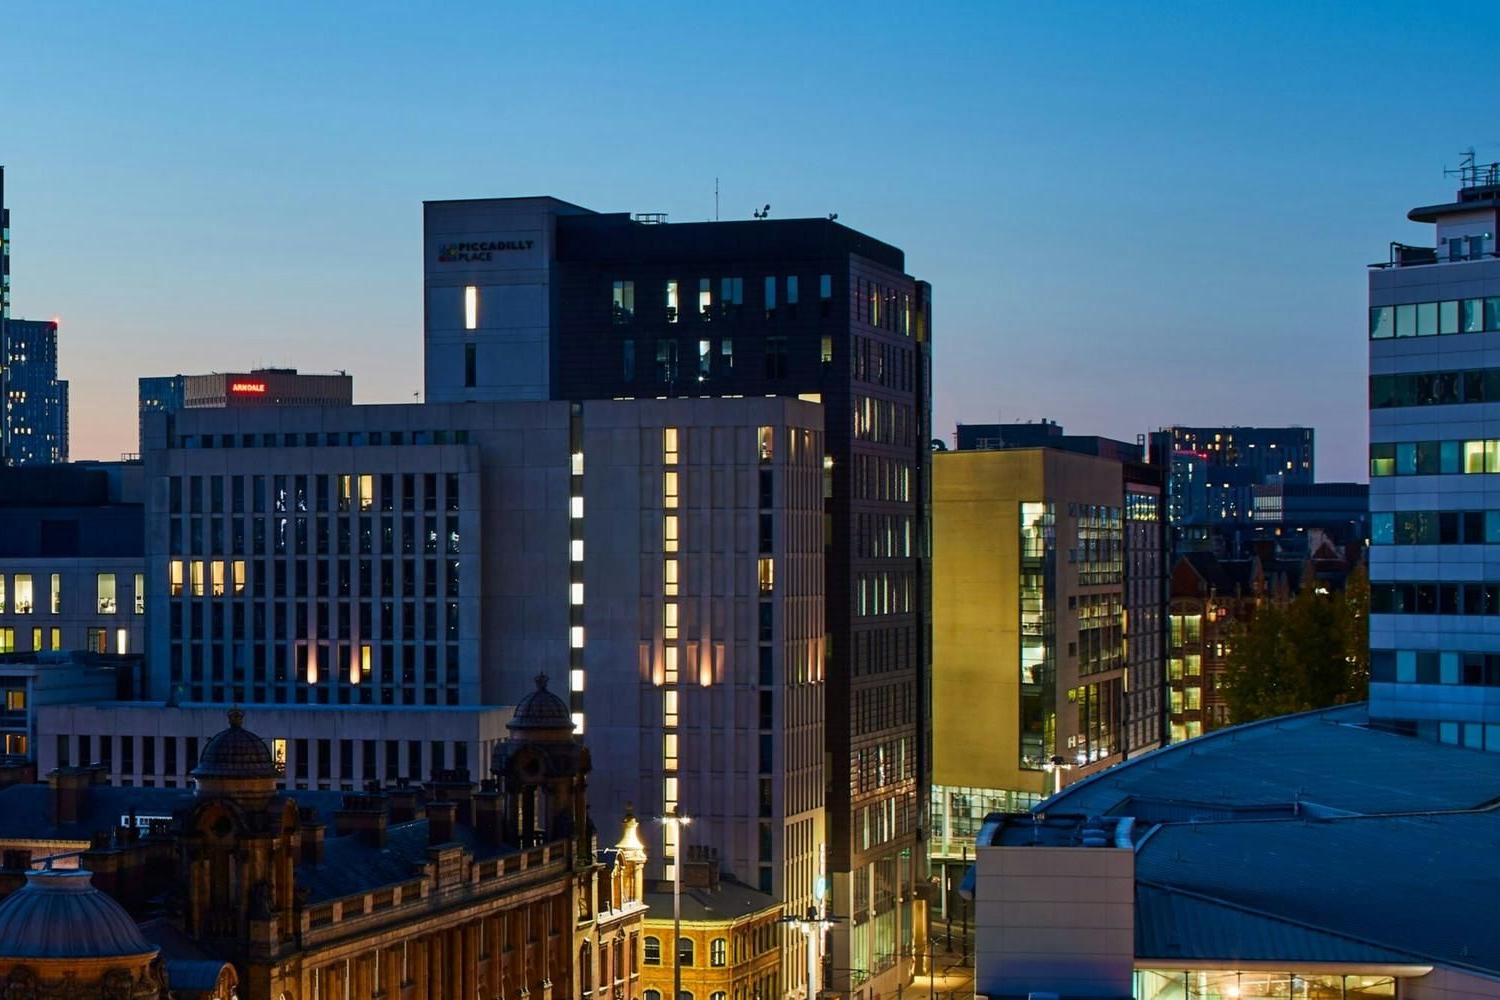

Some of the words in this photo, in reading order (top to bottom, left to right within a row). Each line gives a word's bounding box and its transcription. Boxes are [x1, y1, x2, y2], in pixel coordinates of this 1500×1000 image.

[459, 240, 533, 251] PICCADILLY
[458, 252, 493, 262] PLACE
[231, 383, 265, 392] ARNDALE
